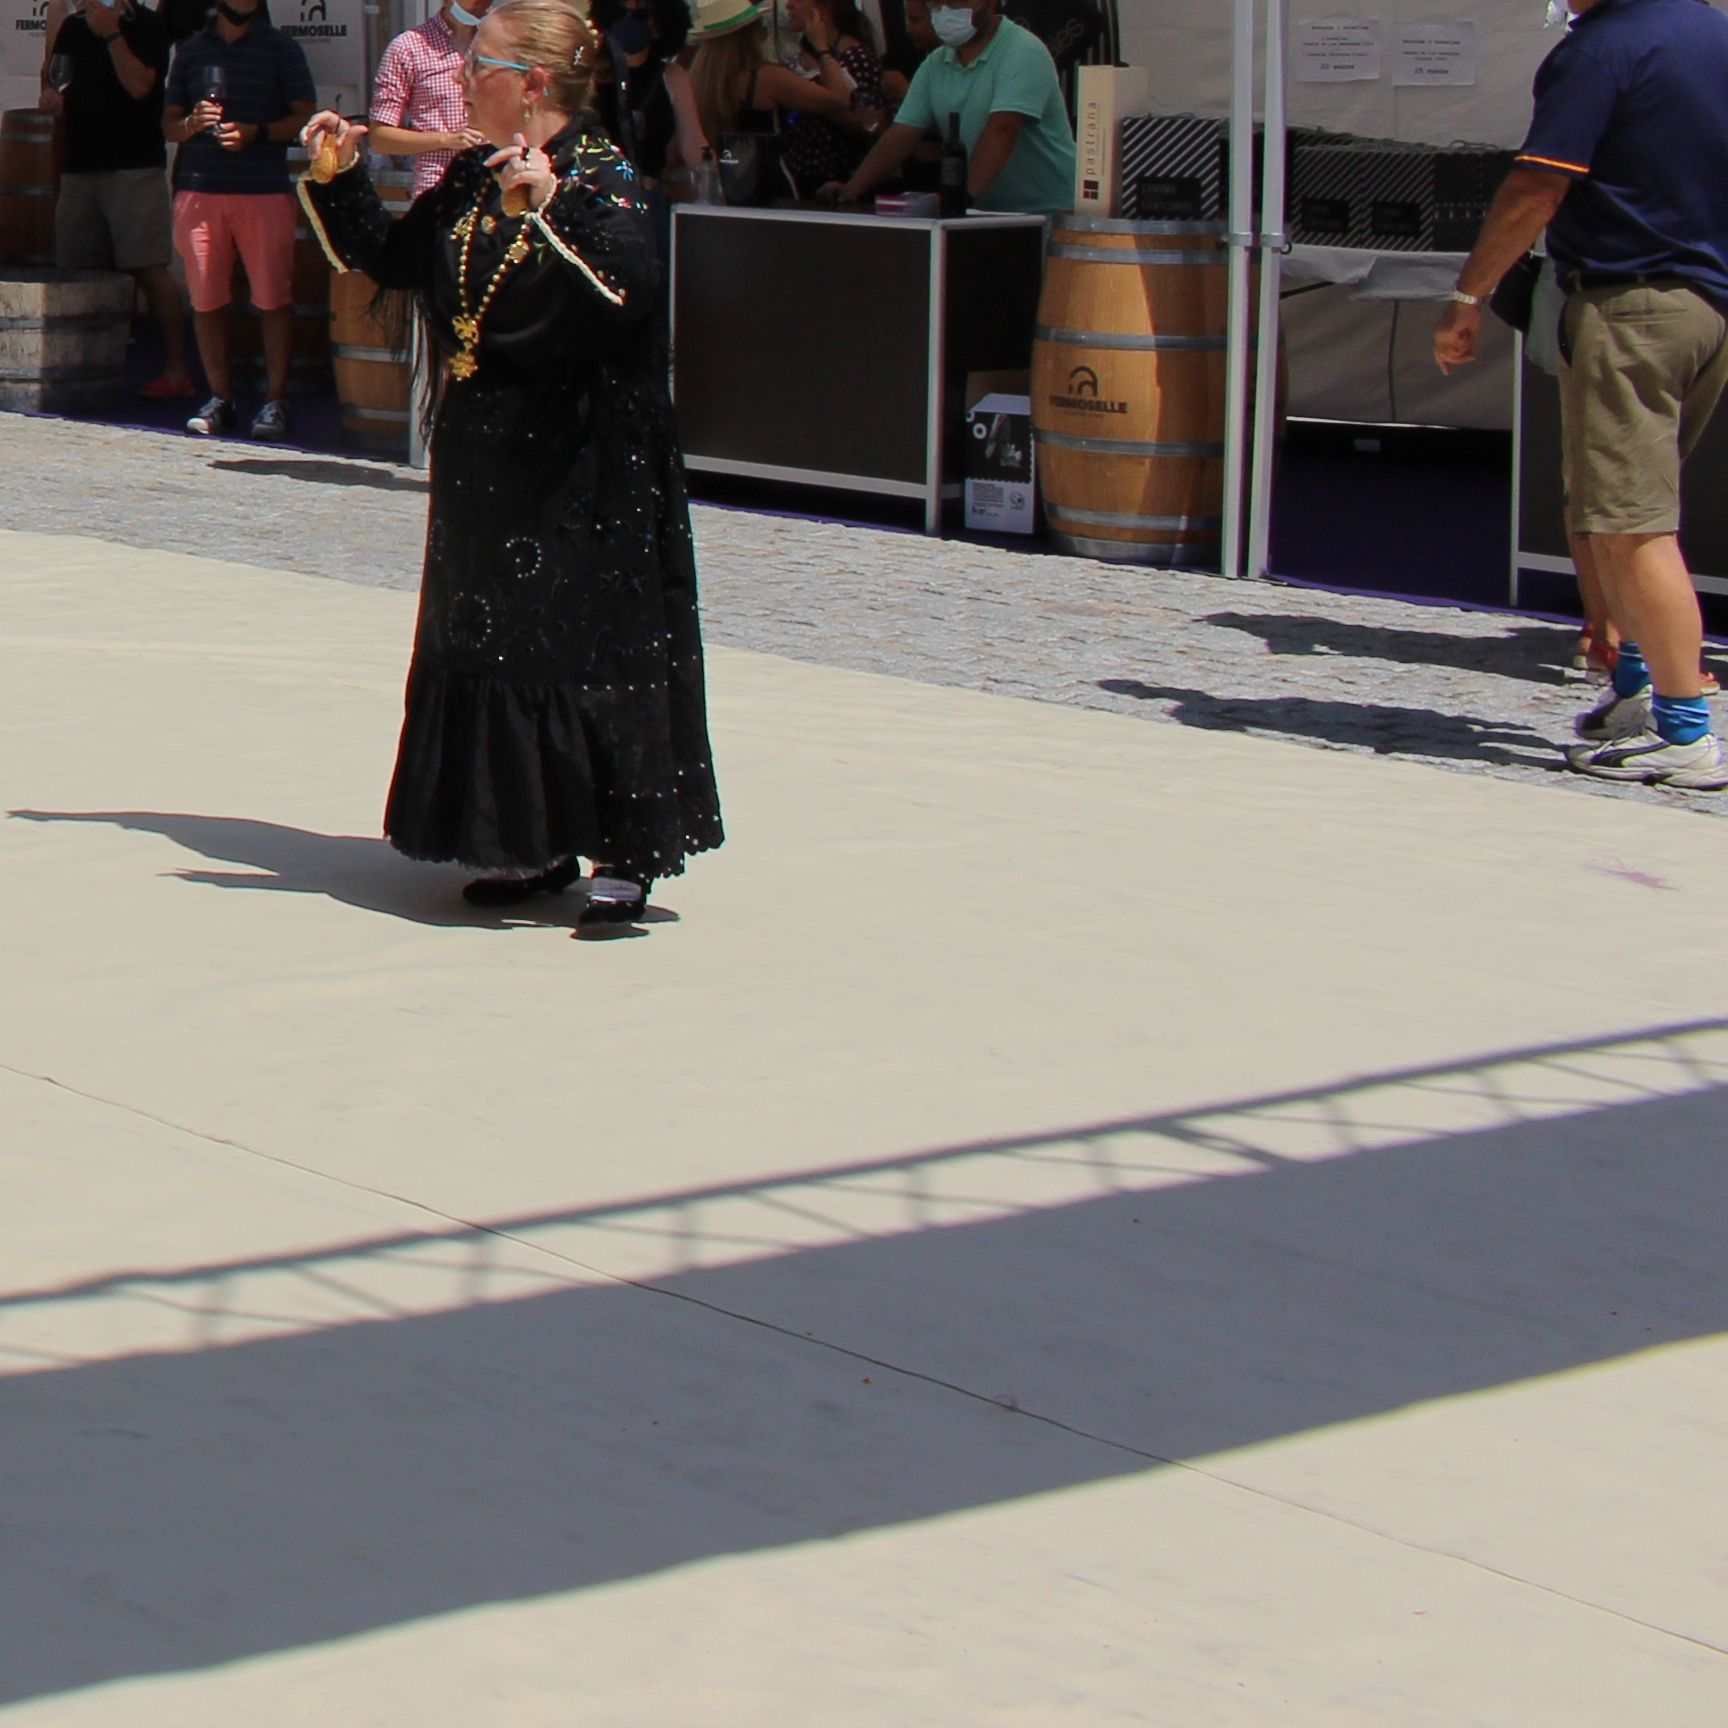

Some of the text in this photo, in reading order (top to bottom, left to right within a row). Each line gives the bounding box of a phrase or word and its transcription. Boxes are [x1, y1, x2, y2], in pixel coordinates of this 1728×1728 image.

[280, 24, 348, 37] FERMOSELLE
[1086, 102, 1098, 176] pastrana
[1050, 394, 1127, 414] FERMOSELLE
